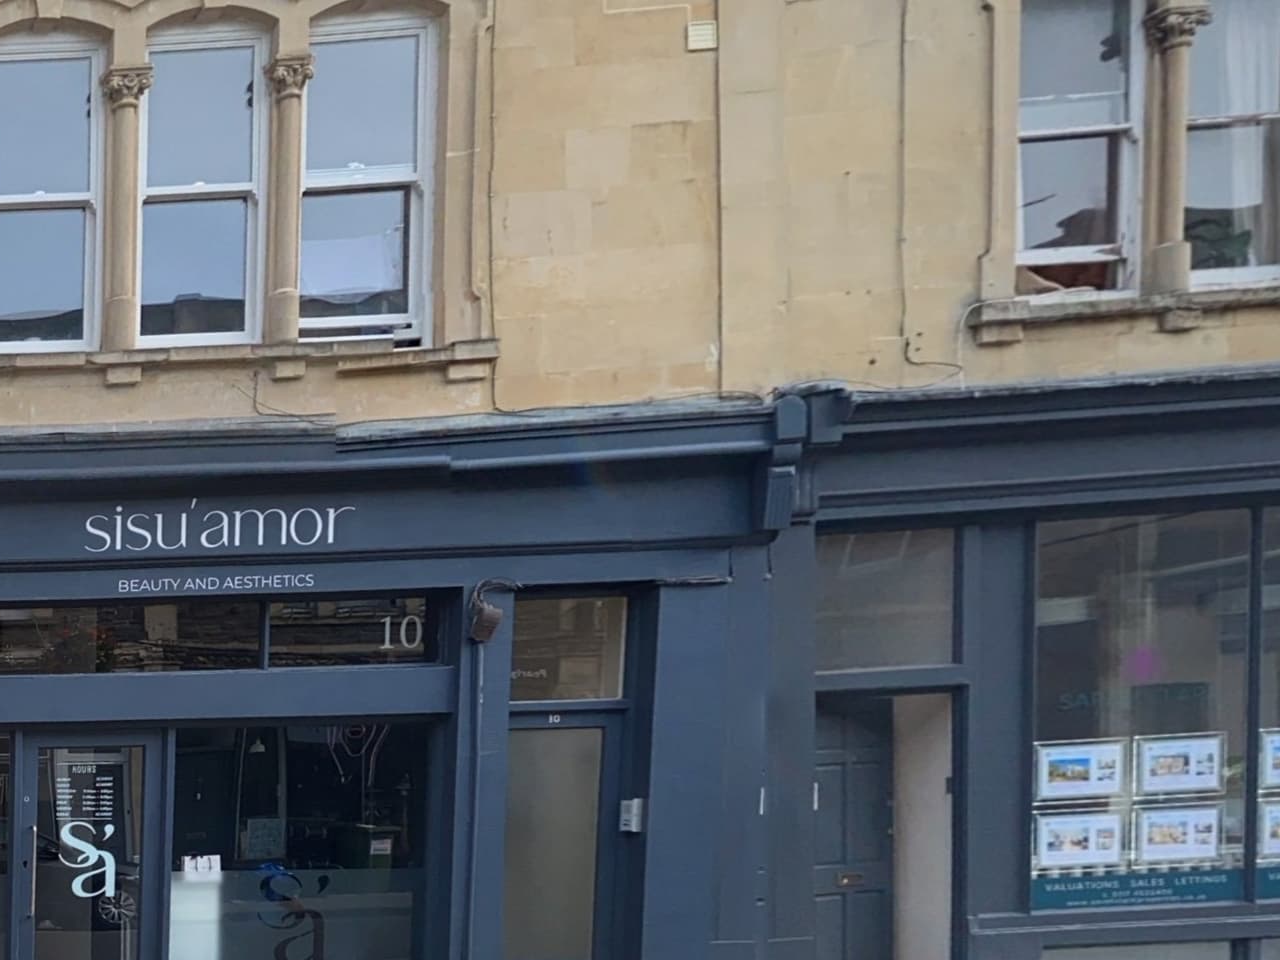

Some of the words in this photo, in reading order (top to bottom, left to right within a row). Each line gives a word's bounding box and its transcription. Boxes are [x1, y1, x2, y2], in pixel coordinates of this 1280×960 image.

[84, 498, 356, 552] sisu'amor
[118, 578, 180, 592] BEAUTY
[183, 577, 220, 590] AND
[223, 574, 315, 589] AESTHETICS
[379, 615, 423, 649] 10
[1044, 880, 1119, 893] VALUATIONS
[1129, 877, 1165, 888] SALES
[1175, 874, 1228, 886] LETTINGS
